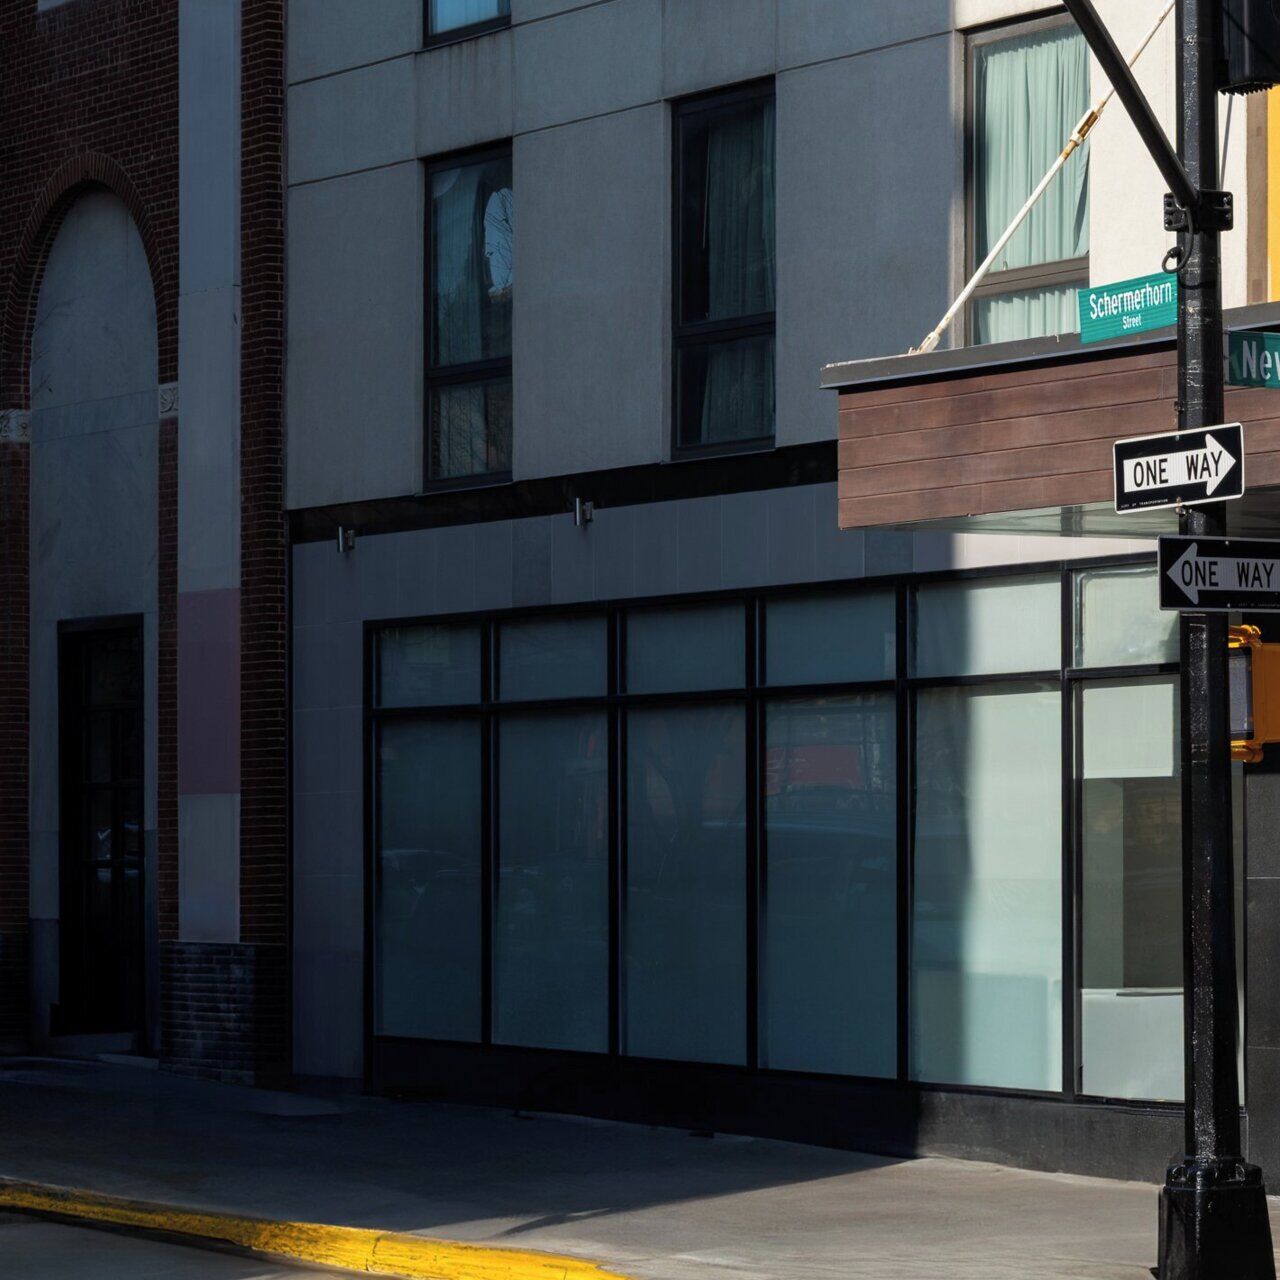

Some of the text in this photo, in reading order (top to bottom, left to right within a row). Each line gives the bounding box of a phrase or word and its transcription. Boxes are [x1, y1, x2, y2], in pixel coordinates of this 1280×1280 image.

[1089, 282, 1171, 320] Schermerhorn
[1122, 313, 1142, 329] Street
[1133, 450, 1223, 488] ONE WAY
[1181, 560, 1275, 588] ONE WAY
